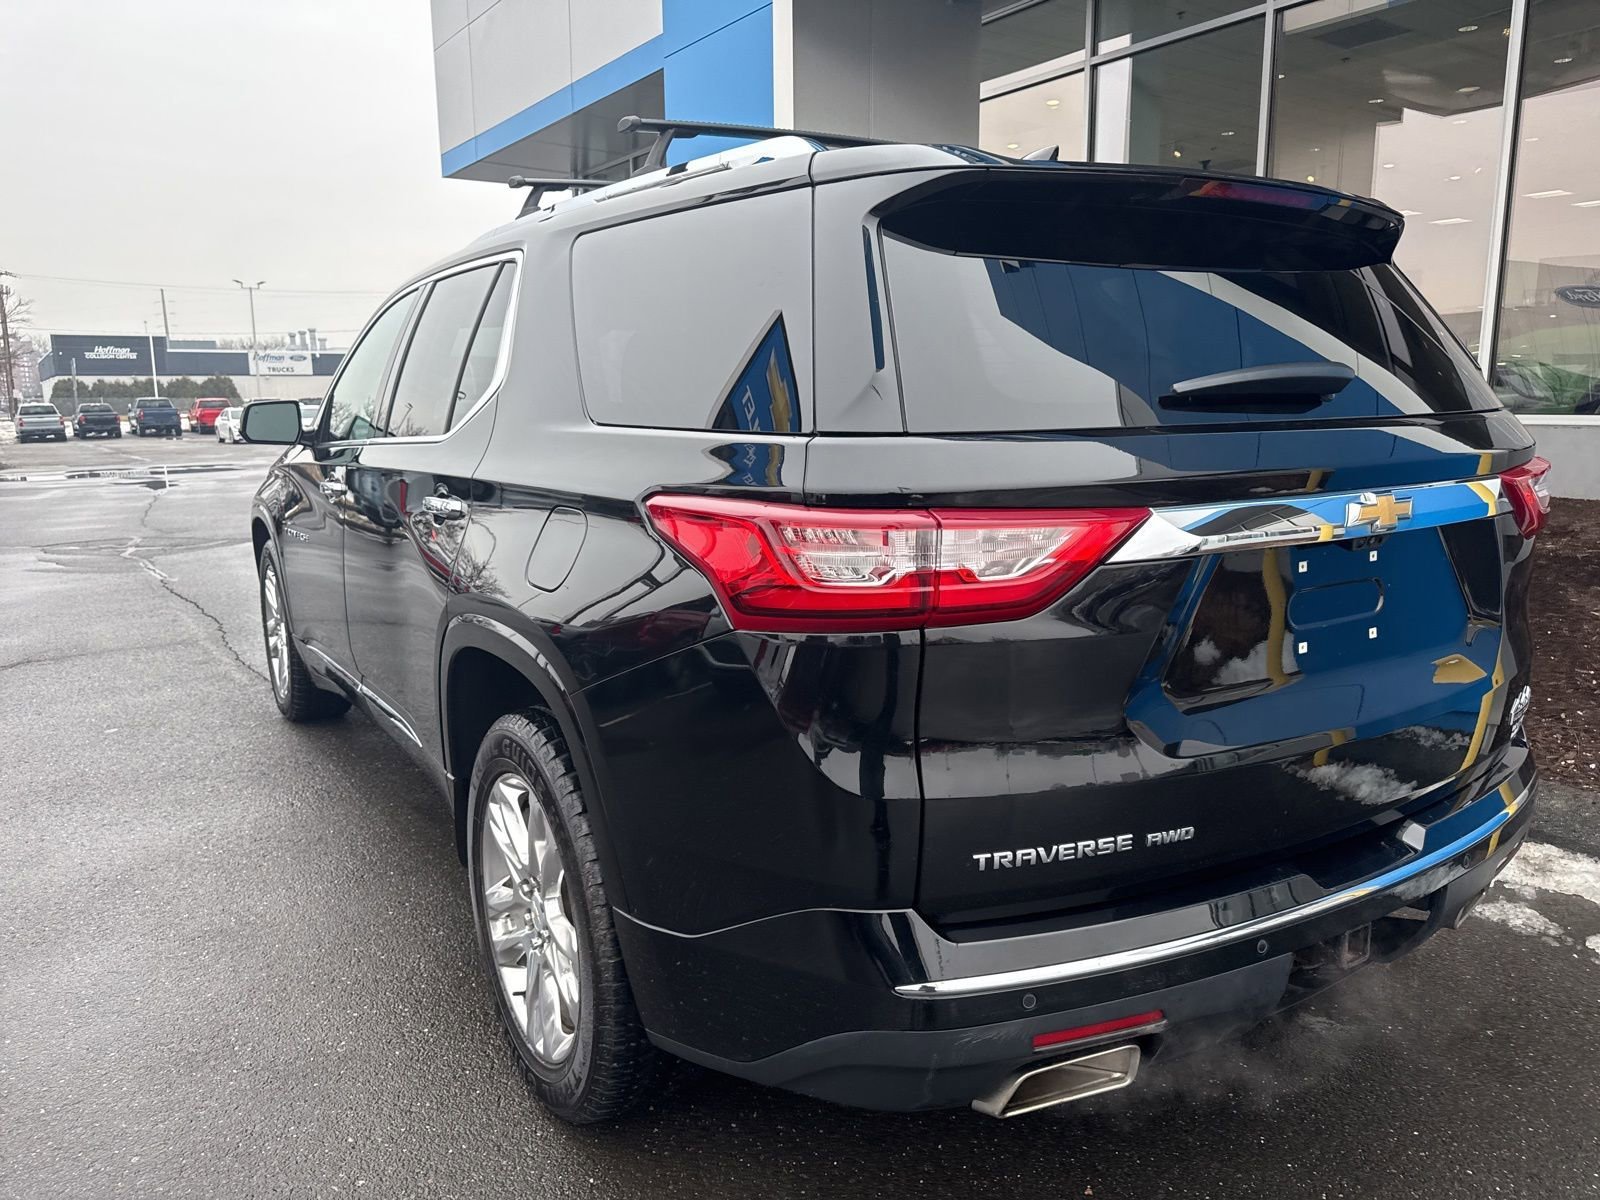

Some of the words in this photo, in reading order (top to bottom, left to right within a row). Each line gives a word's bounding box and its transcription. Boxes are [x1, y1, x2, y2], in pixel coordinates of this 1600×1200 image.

[94, 345, 130, 354] Hoffman
[972, 833, 1134, 872] TRAVERSE
[1145, 826, 1195, 848] AWD
